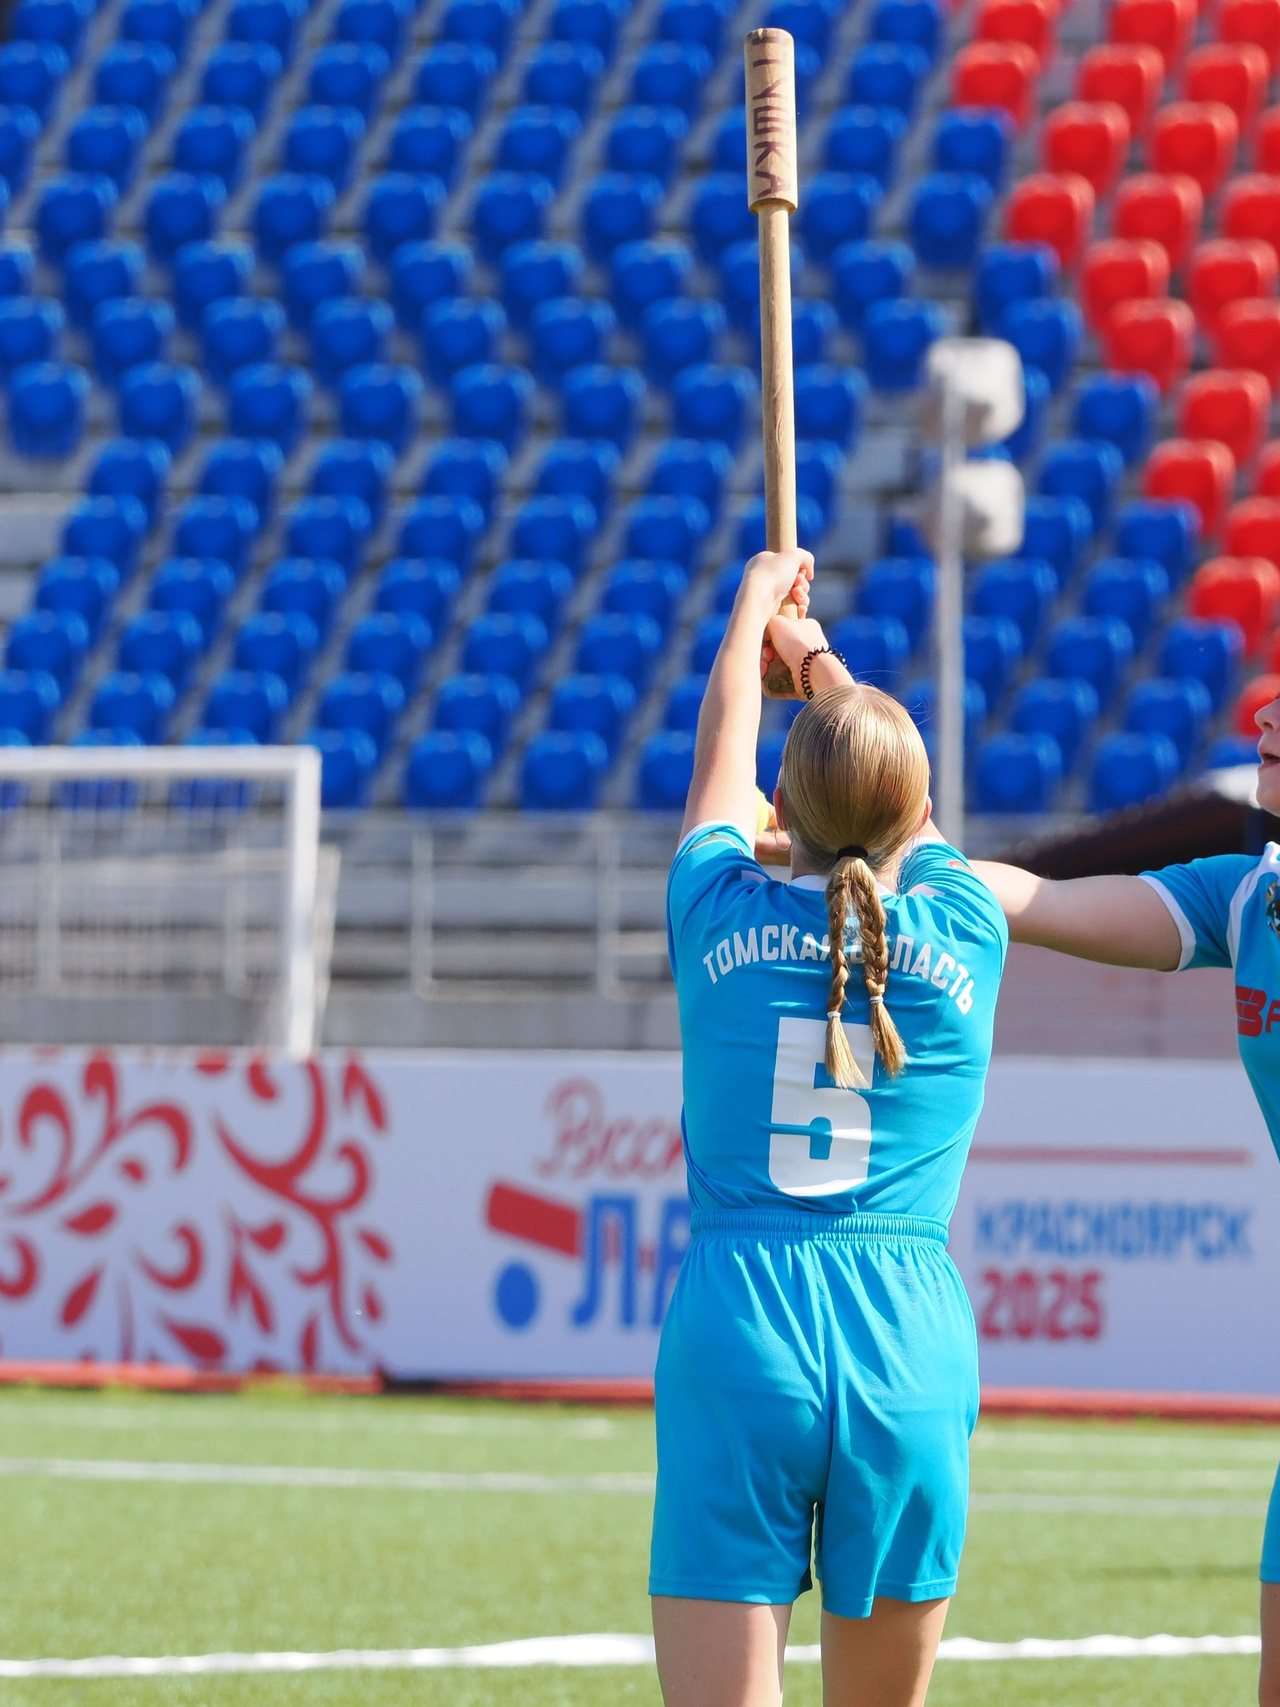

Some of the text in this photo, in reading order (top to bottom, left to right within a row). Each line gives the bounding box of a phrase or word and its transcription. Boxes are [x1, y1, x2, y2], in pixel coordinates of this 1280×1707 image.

[850, 933, 976, 1016] ОЛАСТЬ
[768, 1016, 876, 1197] 5
[976, 1203, 1253, 1257] КРАСНОЯРСК
[981, 1271, 1103, 1339] 2025
